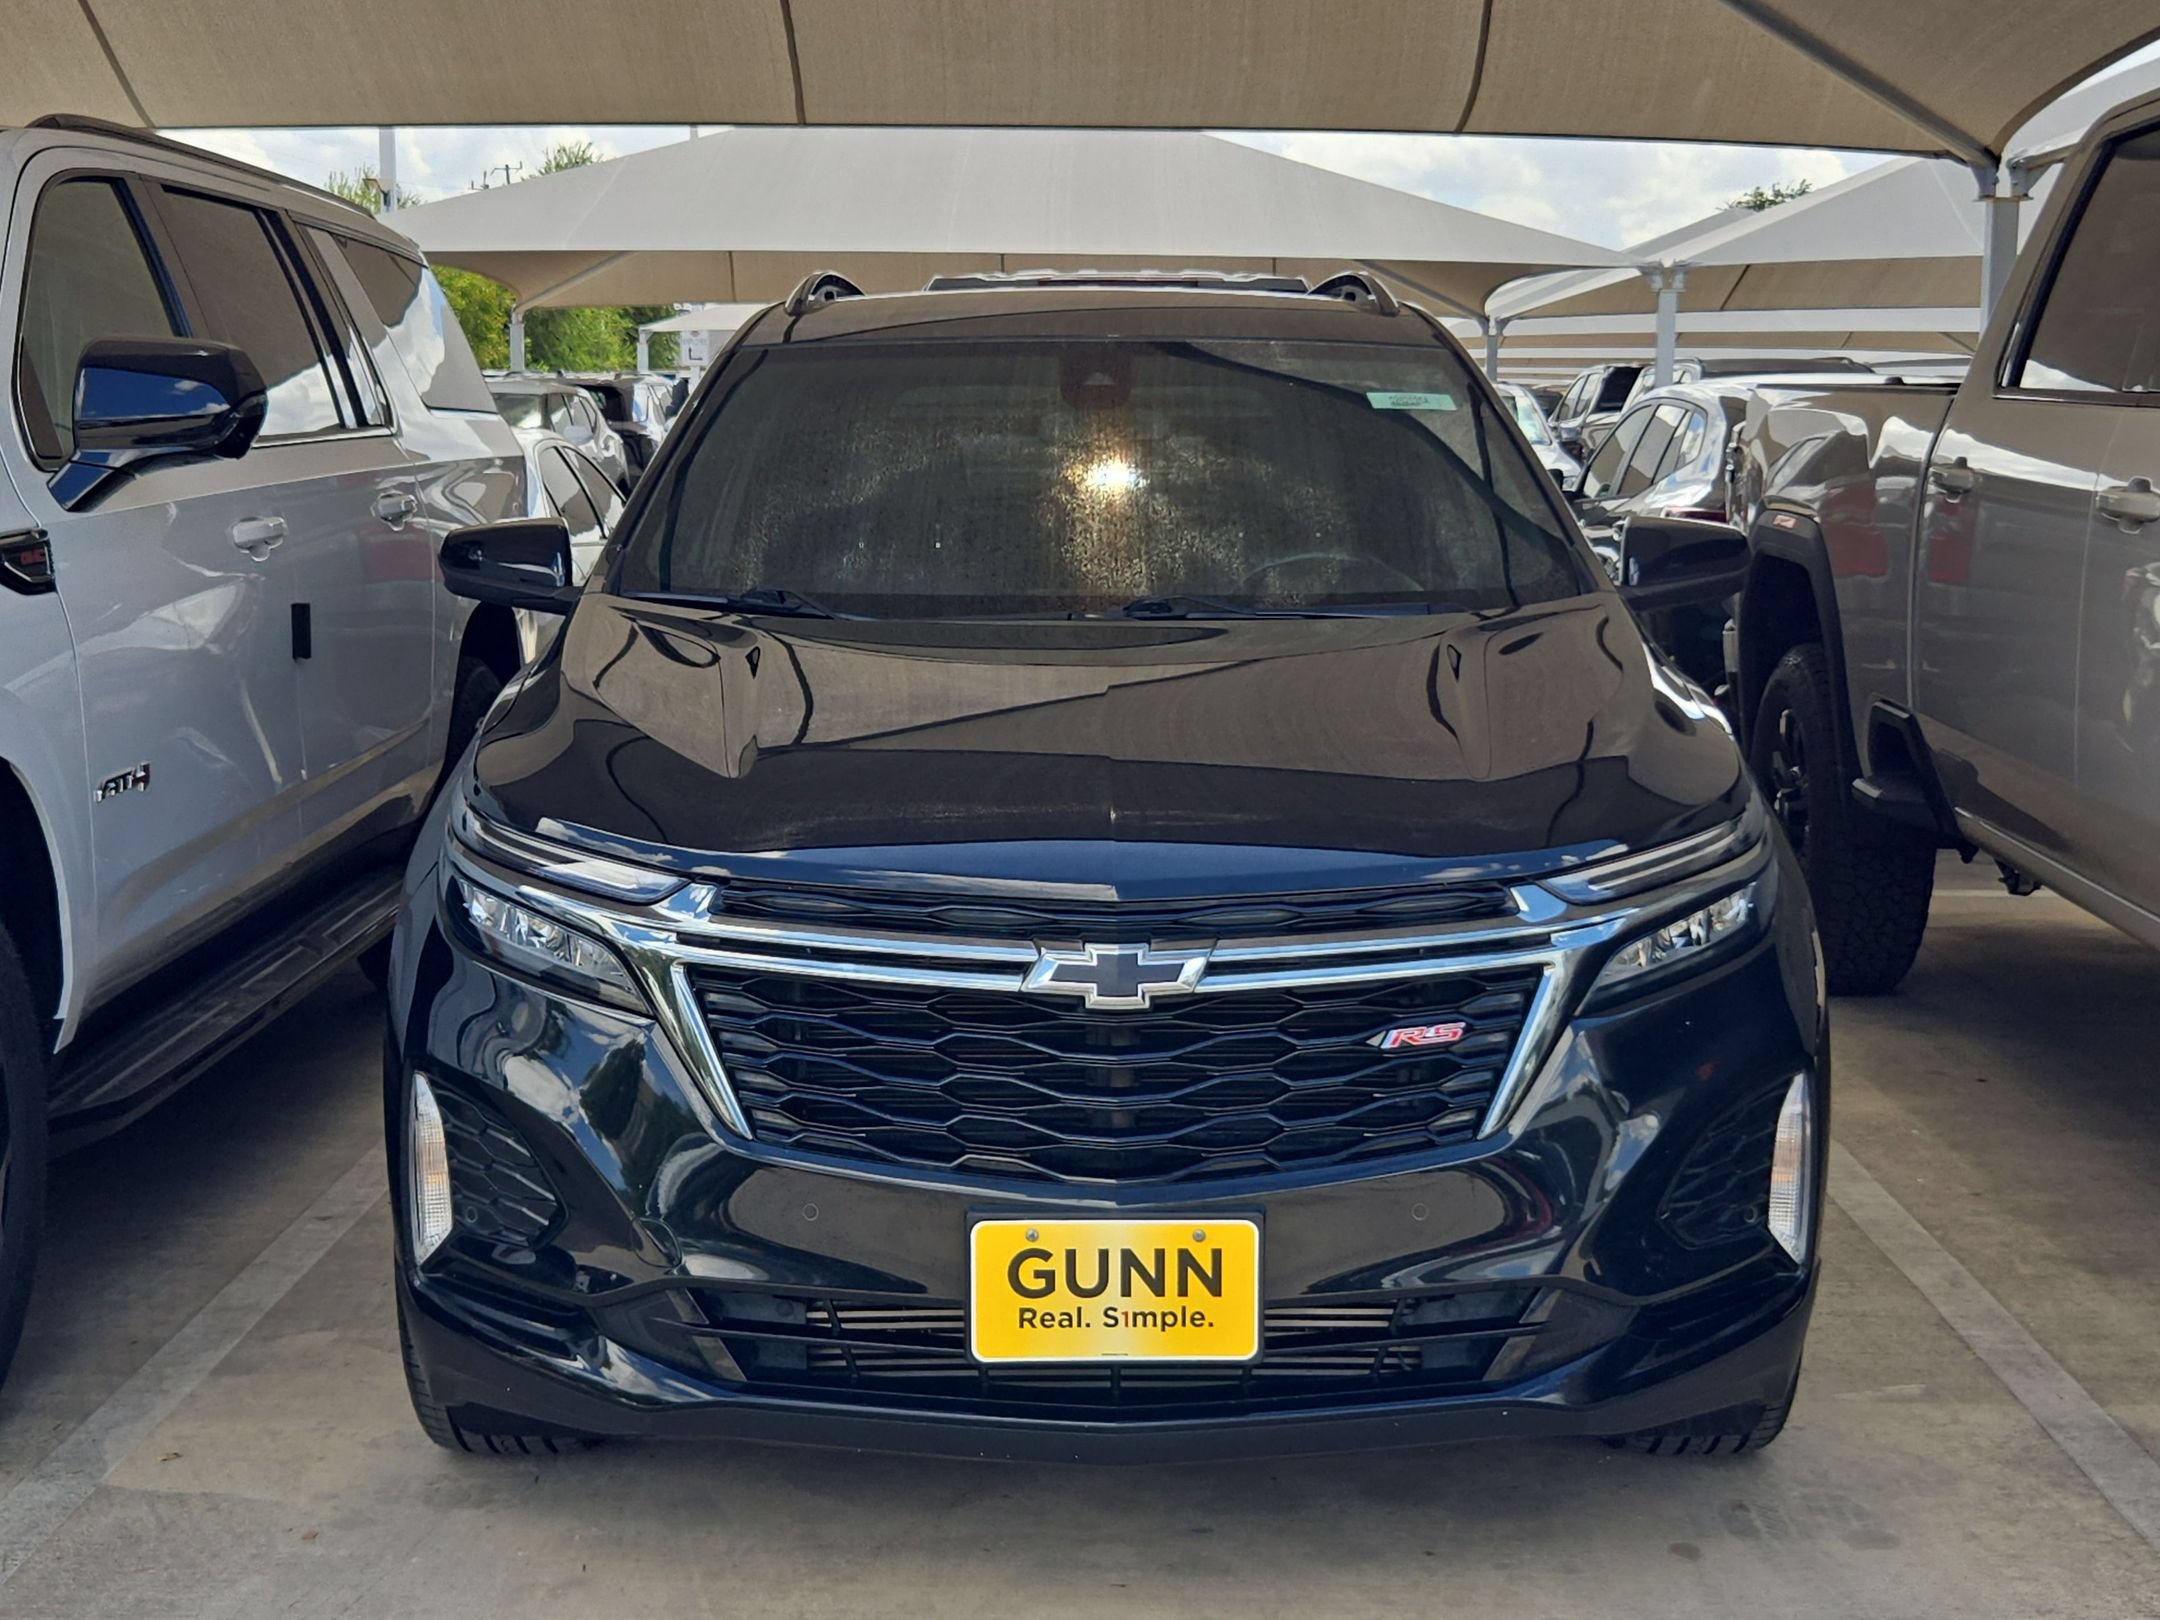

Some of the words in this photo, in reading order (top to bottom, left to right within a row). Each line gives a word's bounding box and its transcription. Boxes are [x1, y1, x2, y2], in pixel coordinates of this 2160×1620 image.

[1381, 1022, 1466, 1048] RS
[1007, 1247, 1223, 1299] GUNN
[1018, 1306, 1091, 1329] Real.
